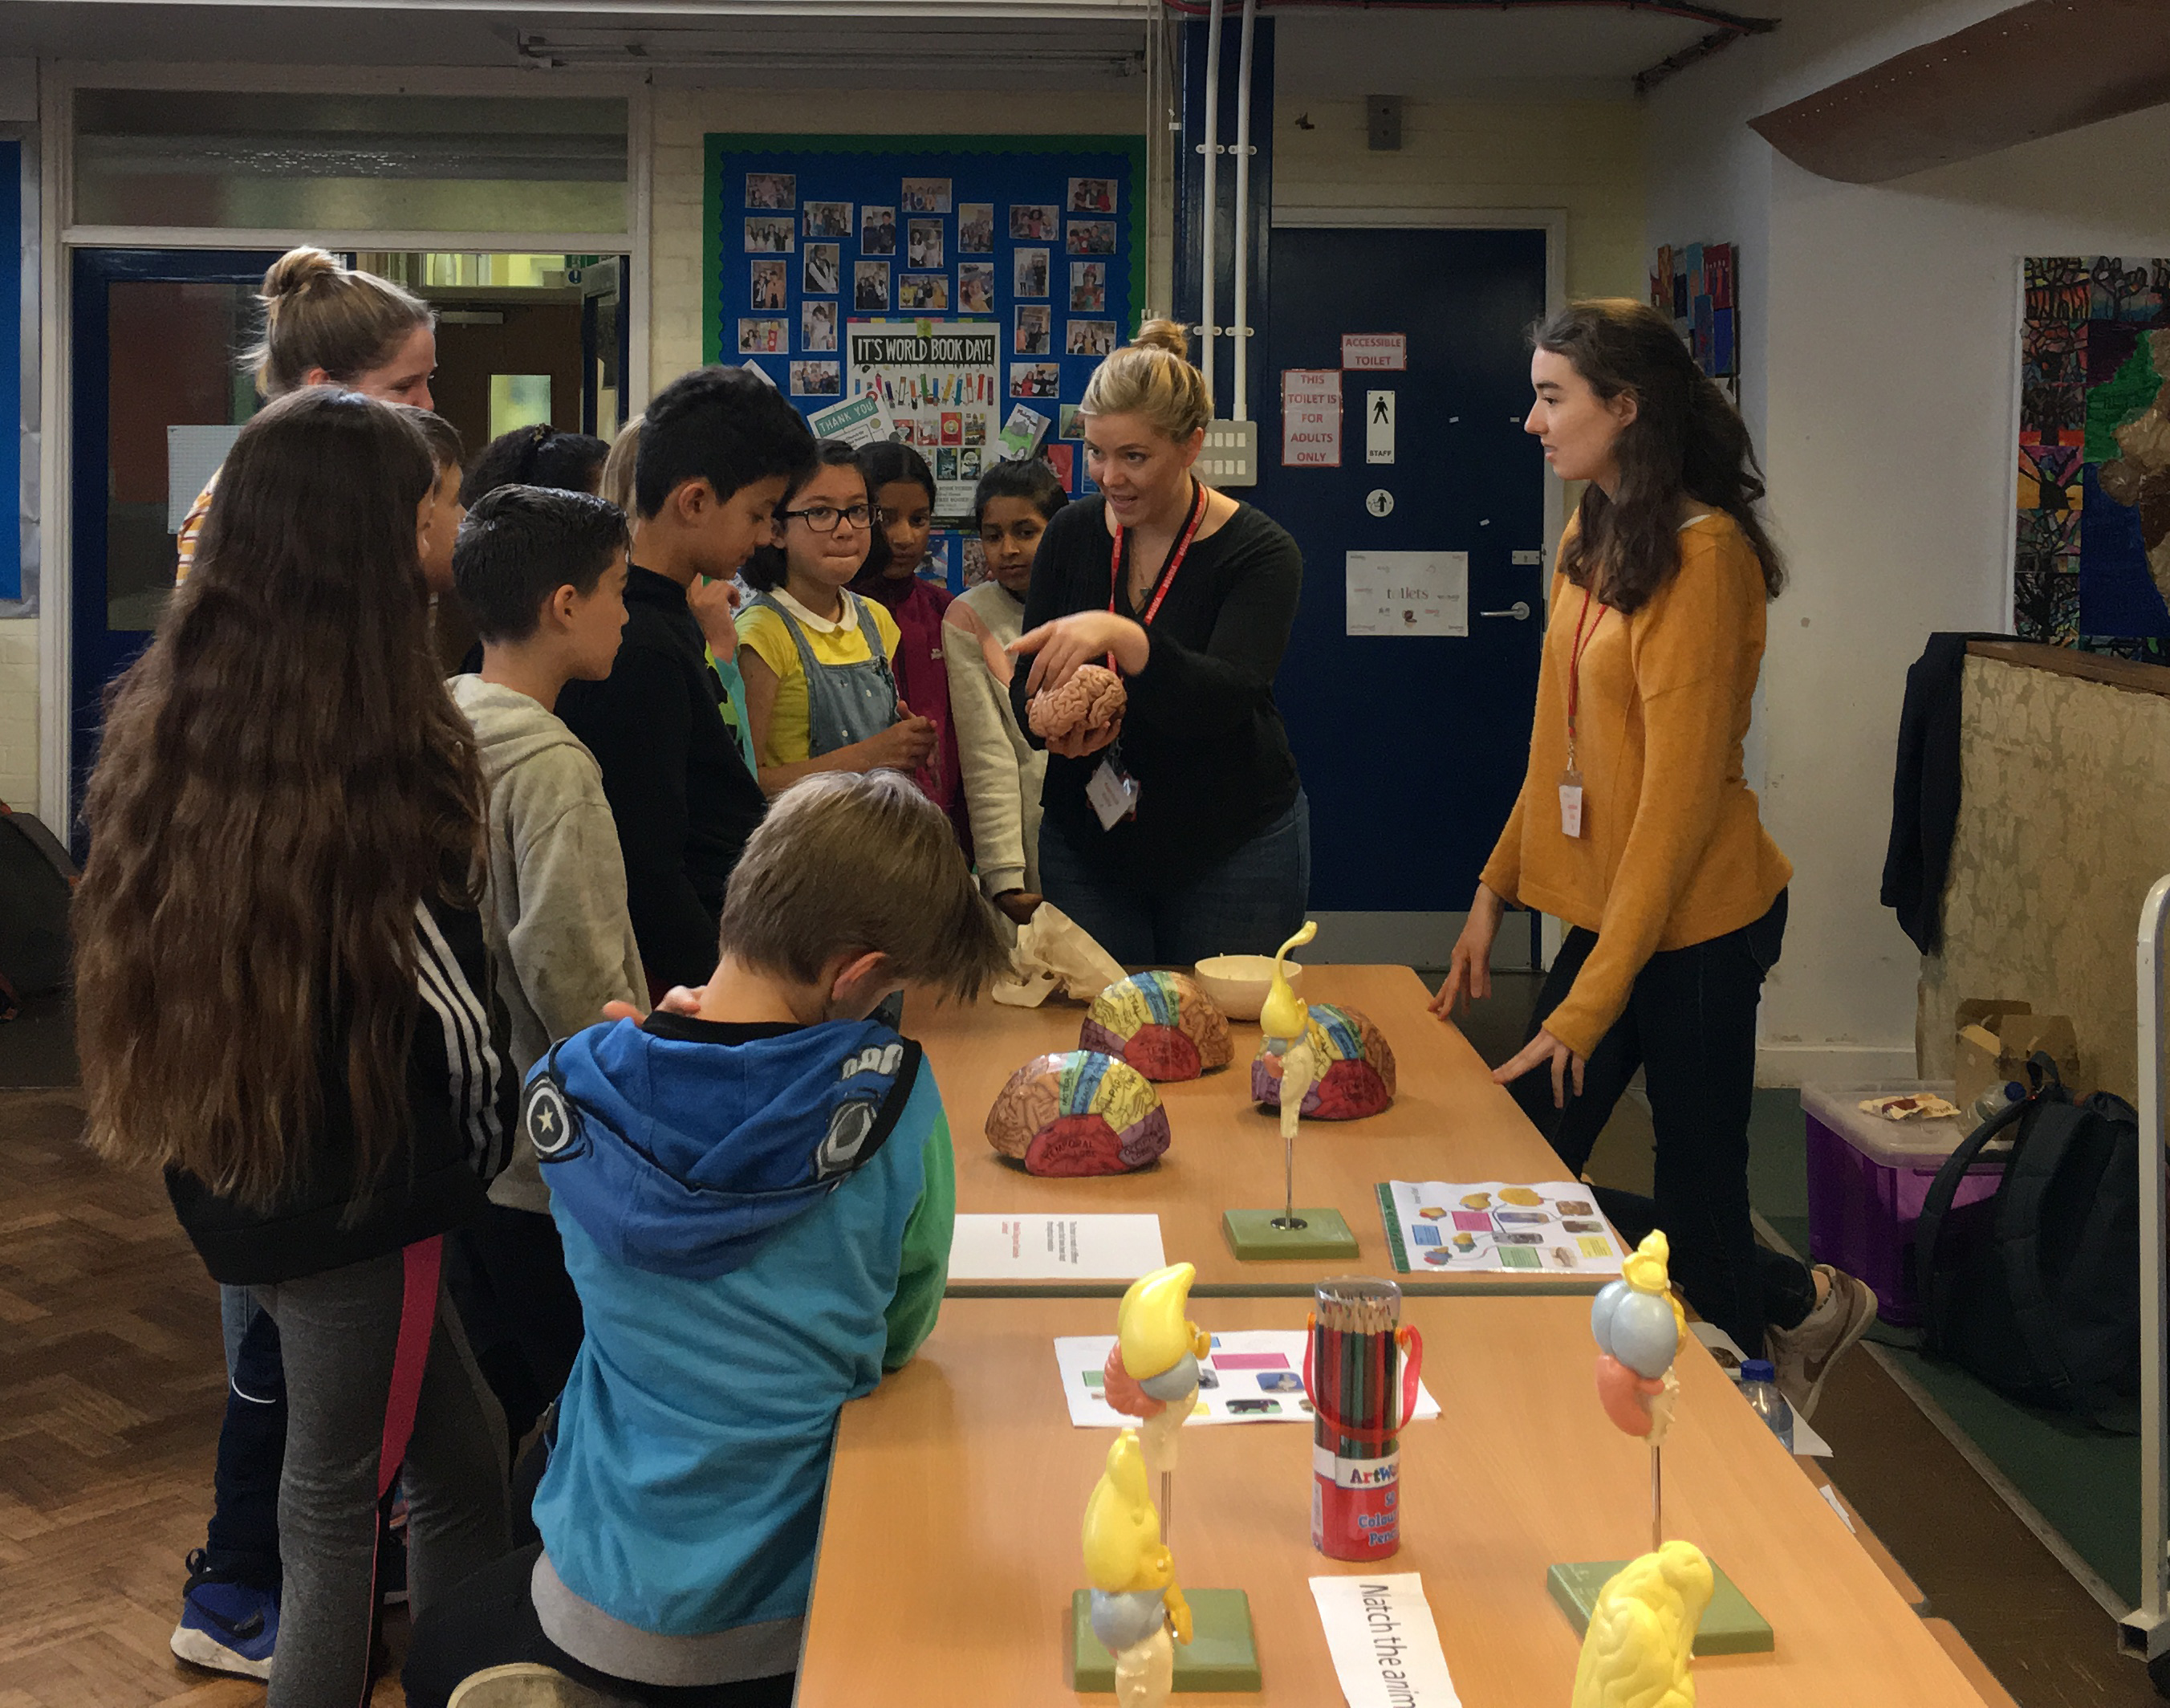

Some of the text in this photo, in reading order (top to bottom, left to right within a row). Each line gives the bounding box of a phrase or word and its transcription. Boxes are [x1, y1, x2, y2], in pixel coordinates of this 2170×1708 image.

[1345, 337, 1401, 348] ACCESSIBLE
[858, 338, 992, 361] IT'S WORLD BOOK DAY!
[1355, 356, 1392, 366] TOILET
[1300, 374, 1324, 384] THIS
[1287, 393, 1337, 404] TOILET IS
[819, 401, 873, 432] THANK YOU
[1302, 413, 1323, 423] FOR
[1290, 433, 1333, 443] ADULTS
[1297, 451, 1327, 462] ONLY
[1369, 449, 1392, 458] STAFF
[1359, 1584, 1402, 1633] Match
[1373, 1637, 1408, 1666] the
